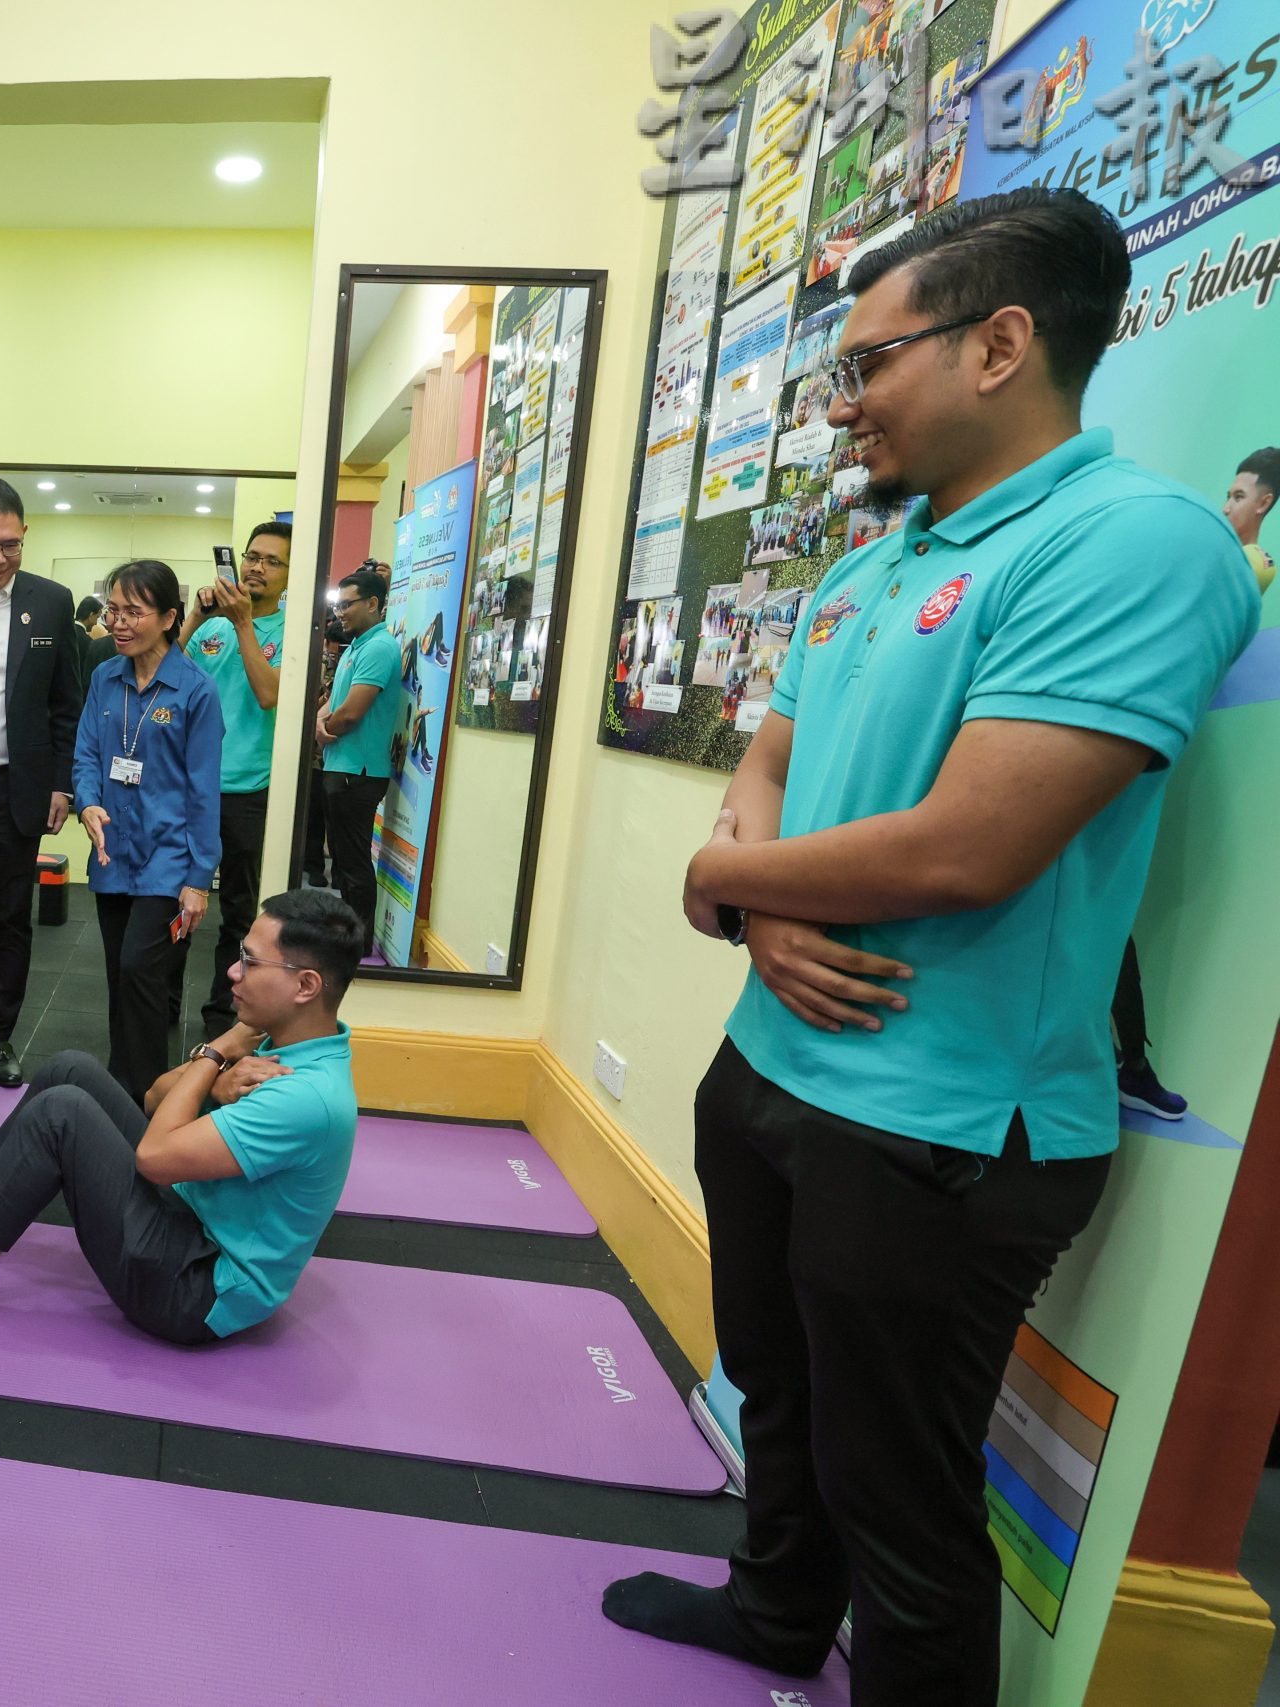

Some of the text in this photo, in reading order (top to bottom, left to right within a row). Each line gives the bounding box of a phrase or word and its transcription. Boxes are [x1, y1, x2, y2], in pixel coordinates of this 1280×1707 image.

[1153, 263, 1187, 328] 5
[507, 1159, 541, 1190] VIGOR
[586, 1346, 636, 1403] VIGOR
